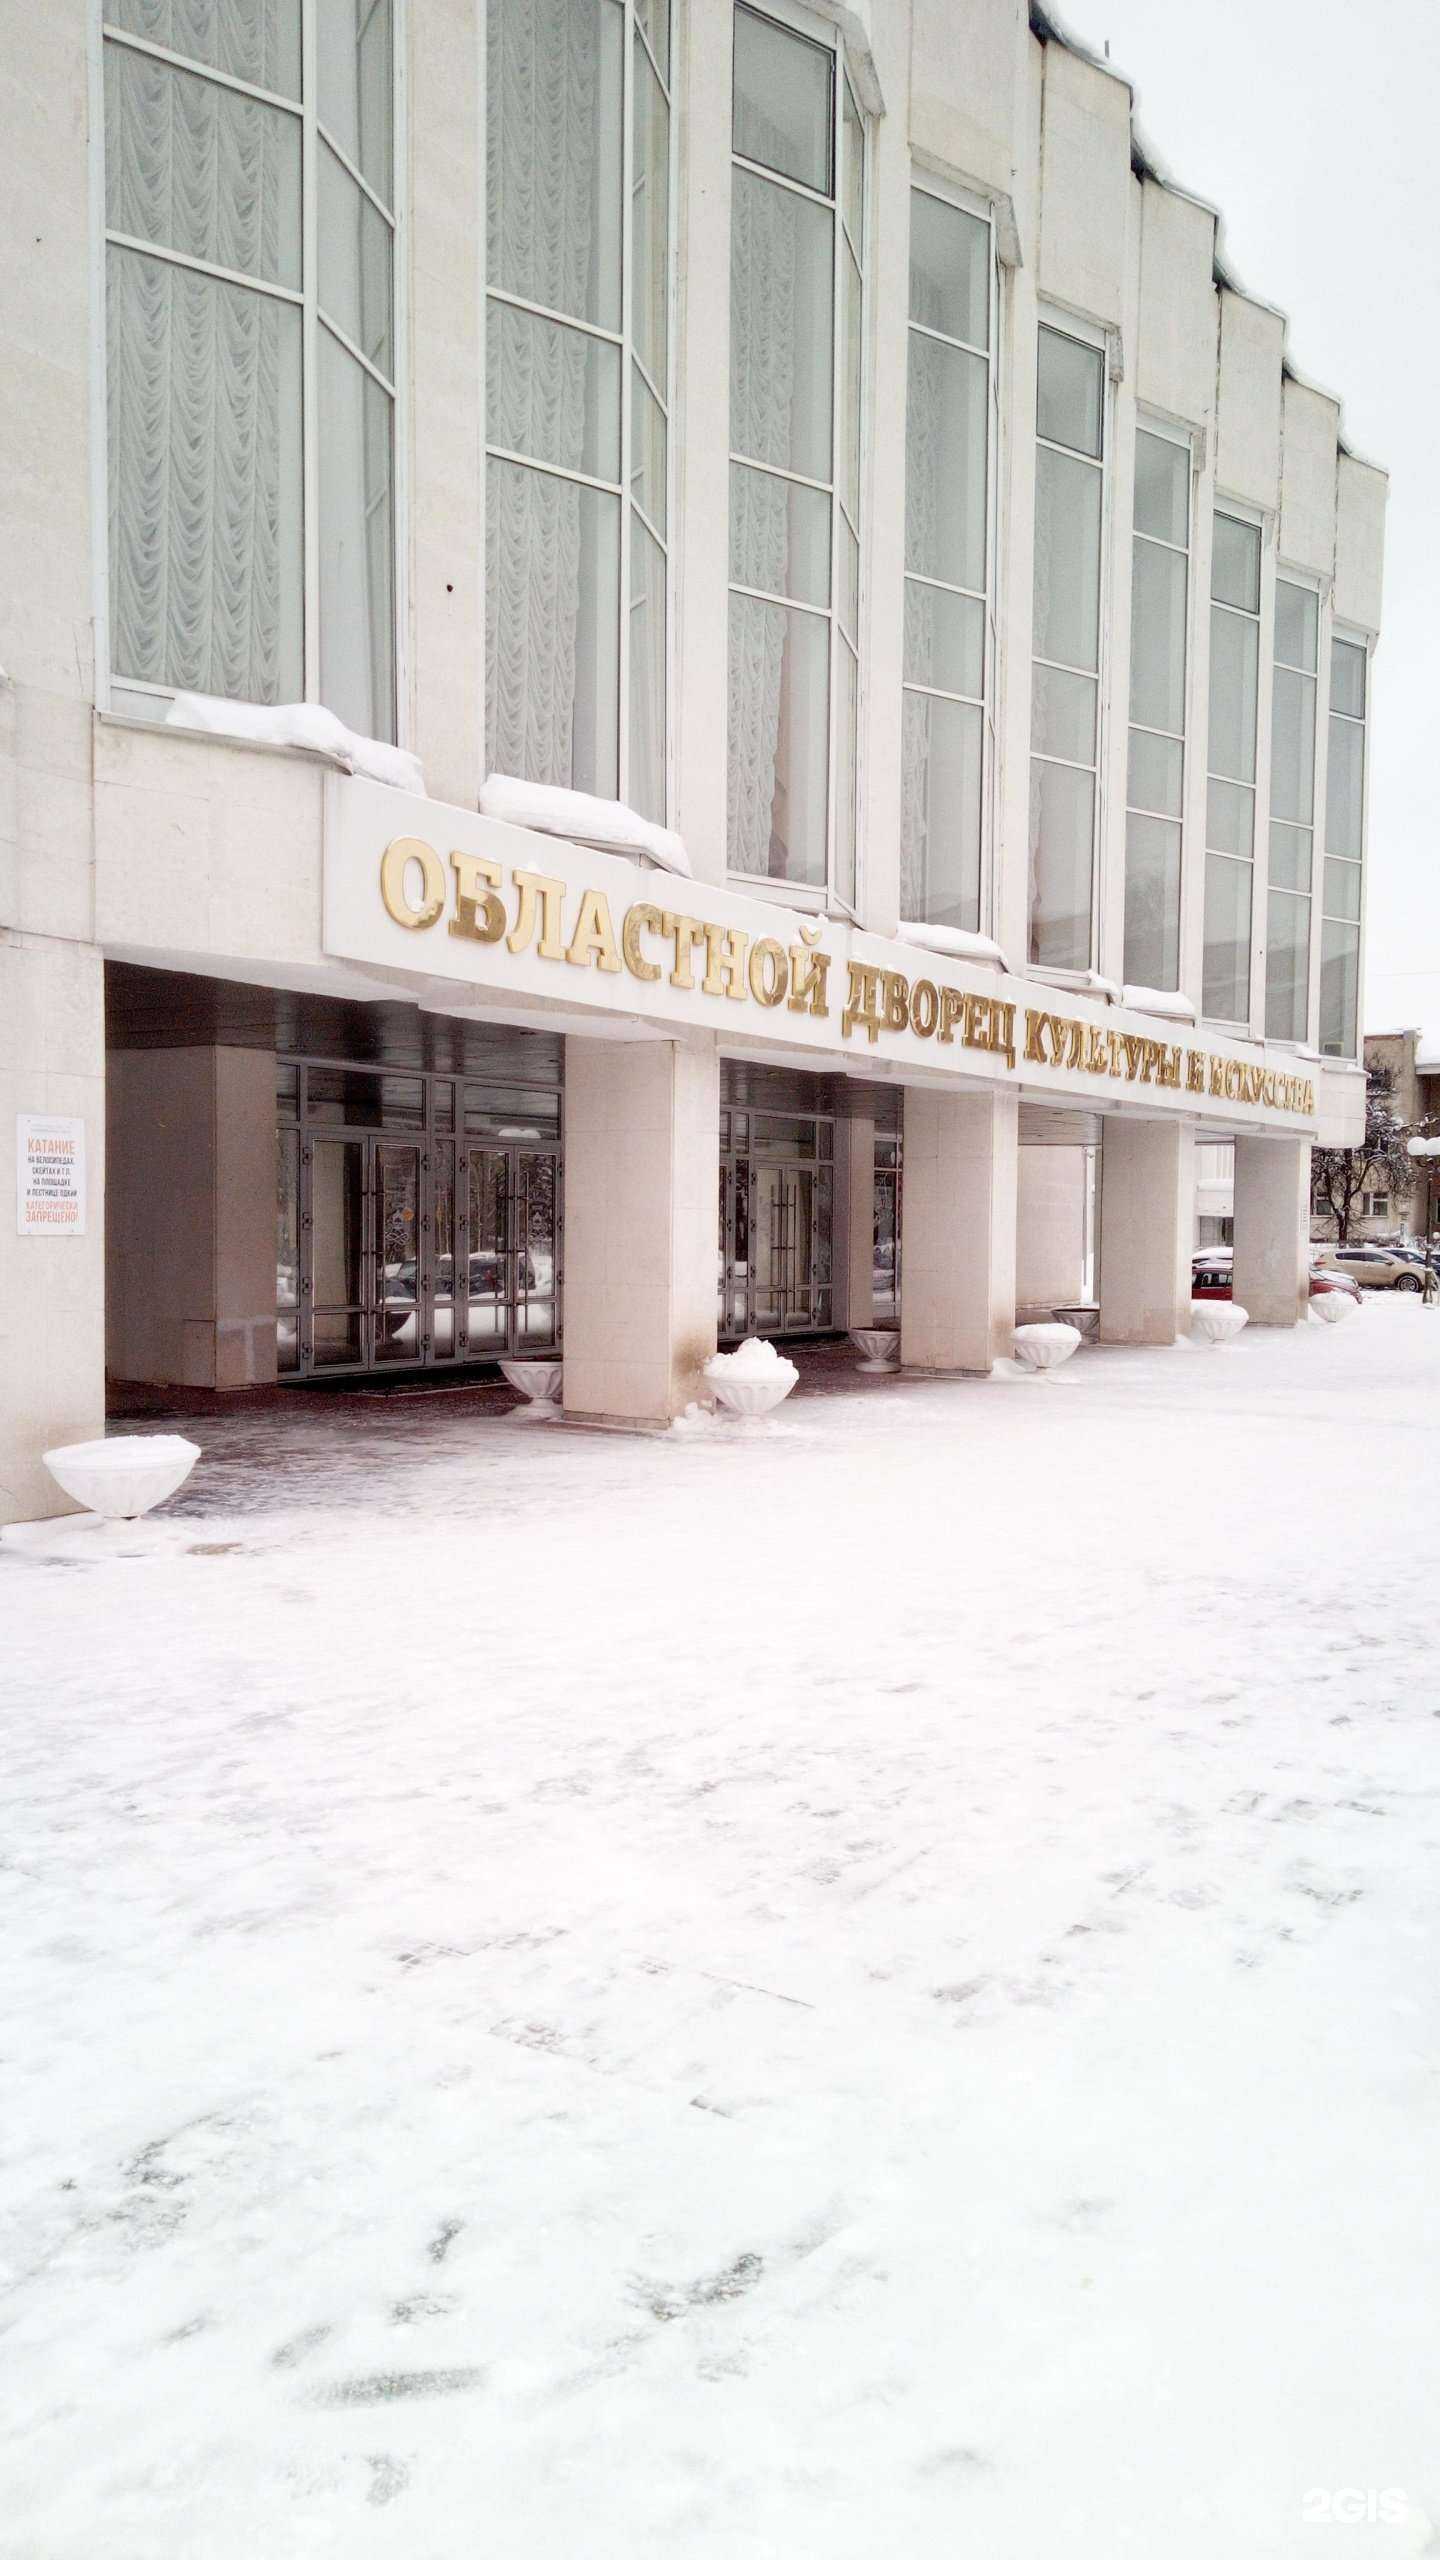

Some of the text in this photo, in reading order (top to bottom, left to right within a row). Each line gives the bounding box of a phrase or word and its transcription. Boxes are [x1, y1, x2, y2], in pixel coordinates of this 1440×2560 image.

[380, 836, 1316, 1116] ОБЛАСТНОЙ ДВОРЕЦ КУЛЬТУРЫ И ИСКУССТВА
[28, 1136, 75, 1154] КАТАНИЕ
